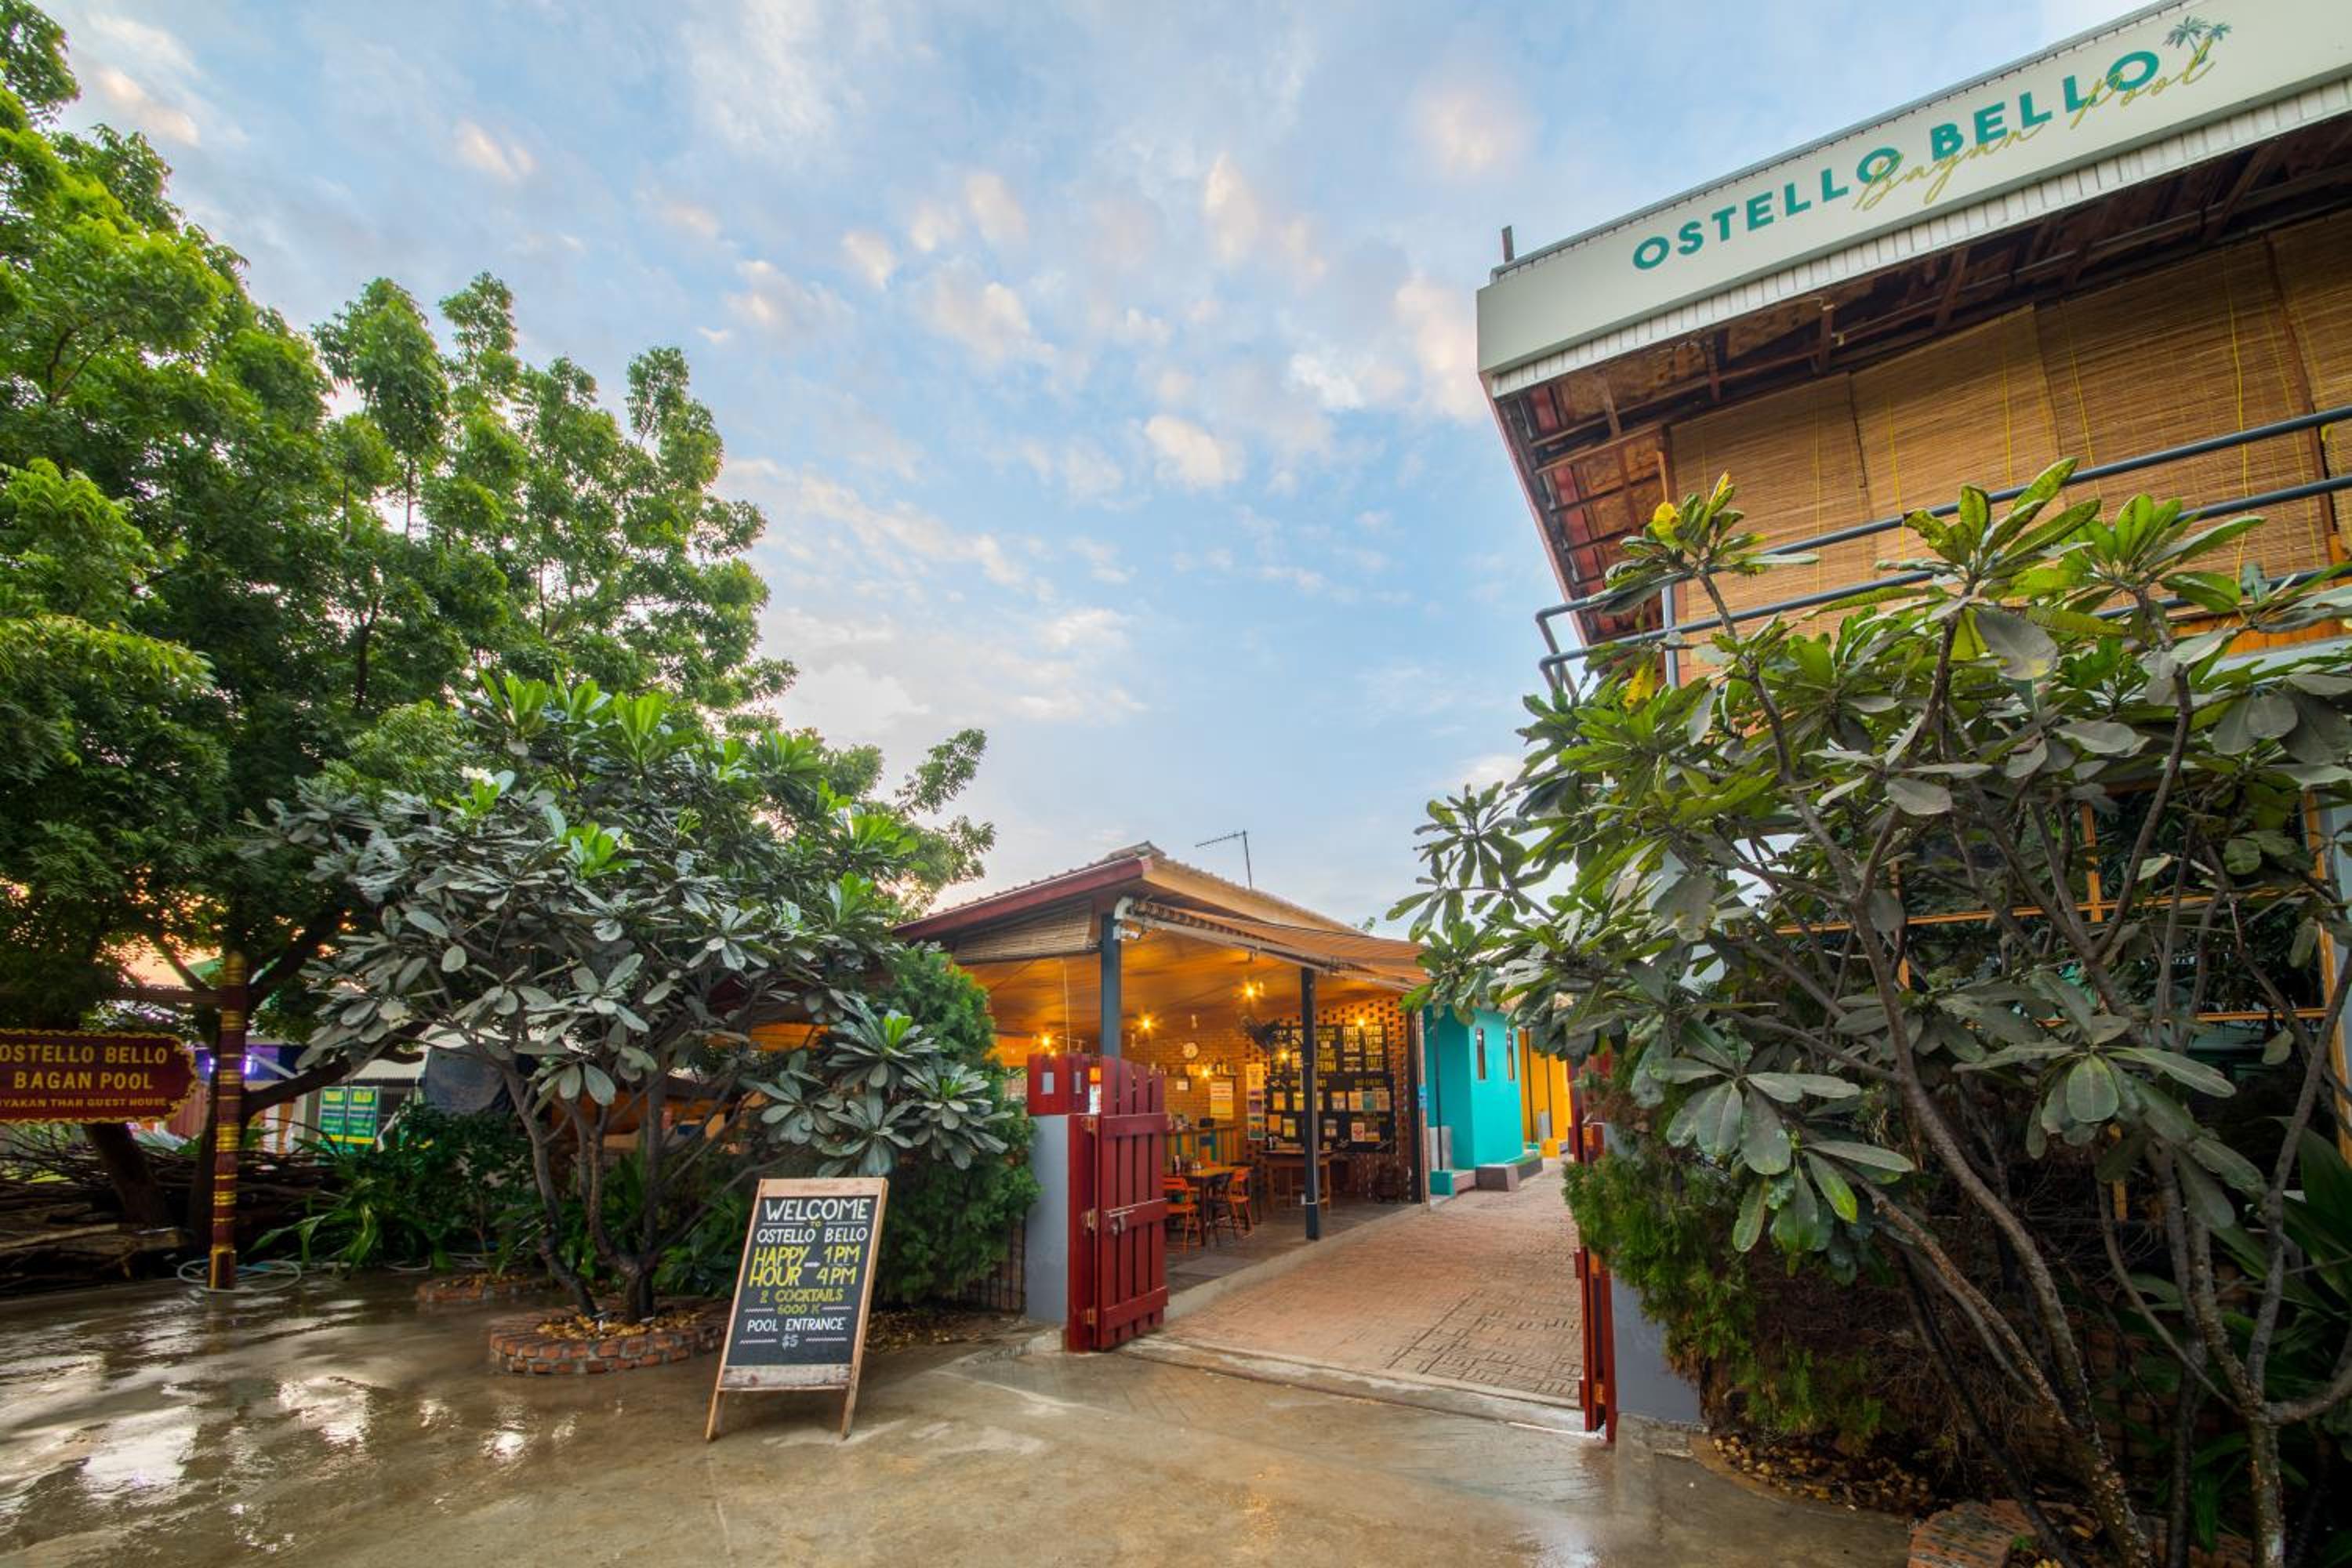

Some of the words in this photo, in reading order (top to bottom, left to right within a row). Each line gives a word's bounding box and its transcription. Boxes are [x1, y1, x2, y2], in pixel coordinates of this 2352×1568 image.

[1852, 125, 2045, 212] Bagan
[2069, 35, 2216, 131] Pool
[1632, 147, 1901, 270] OSTELLO
[1929, 51, 2159, 162] BELLO
[0, 1044, 95, 1063] OSTELLO
[104, 1046, 169, 1064] BELLO
[13, 1071, 93, 1090] BAGAN
[100, 1073, 154, 1090] POOL
[86, 1098, 126, 1107] GUEST
[765, 1199, 872, 1221] WELCOME
[757, 1229, 816, 1243] OSTELLO
[824, 1227, 868, 1243] BELLO
[753, 1245, 811, 1269] HAPPY
[824, 1245, 861, 1264] 1PM
[748, 1265, 803, 1287] HOUR
[816, 1266, 857, 1286] 4PM
[760, 1290, 770, 1304] 2
[774, 1288, 844, 1304] COCKTAILS
[746, 1318, 779, 1332] POOL
[785, 1316, 846, 1331] ENTRANCE
